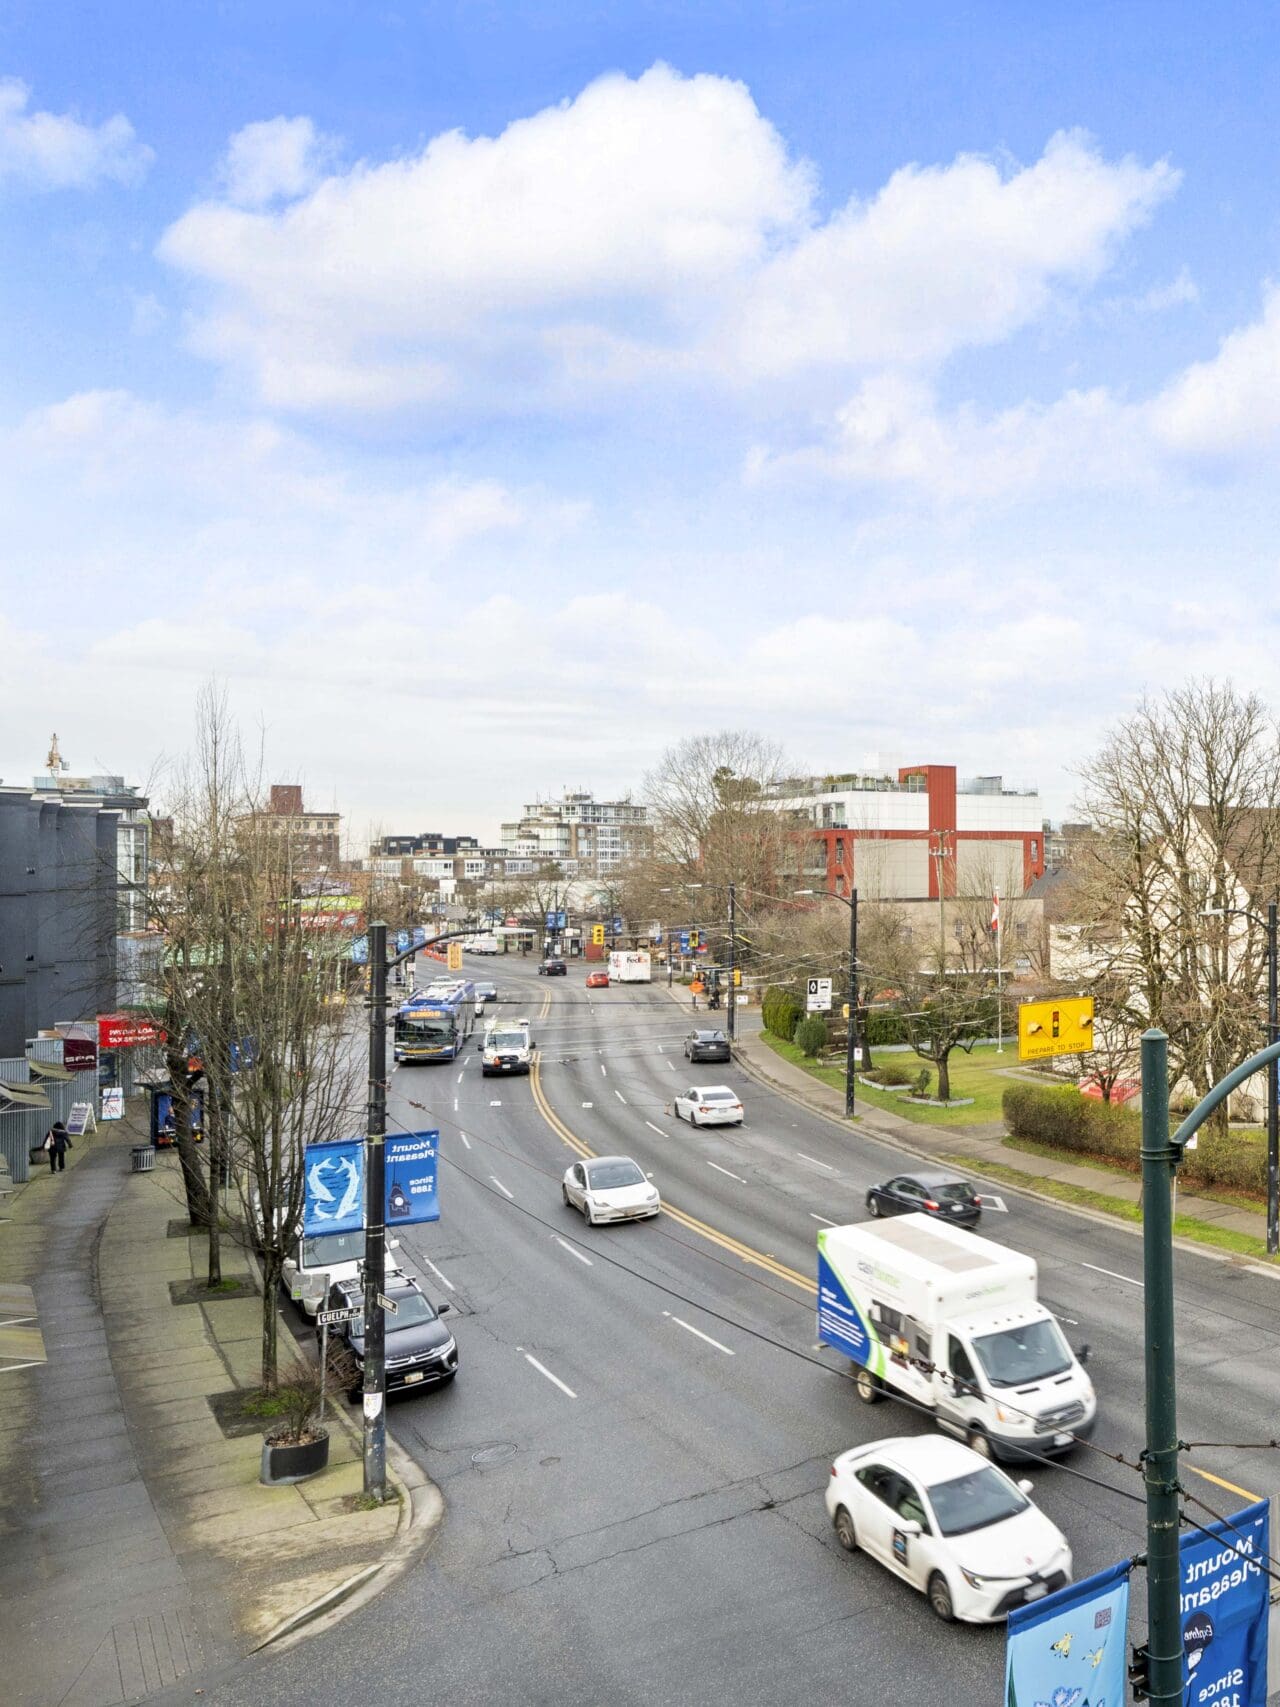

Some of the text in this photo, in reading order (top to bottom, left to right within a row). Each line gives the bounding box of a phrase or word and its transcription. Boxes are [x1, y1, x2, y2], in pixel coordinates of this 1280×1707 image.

[1027, 1045, 1054, 1055] PREPARE
[1068, 1042, 1085, 1050] STOP
[321, 1310, 349, 1323] GUELPH
